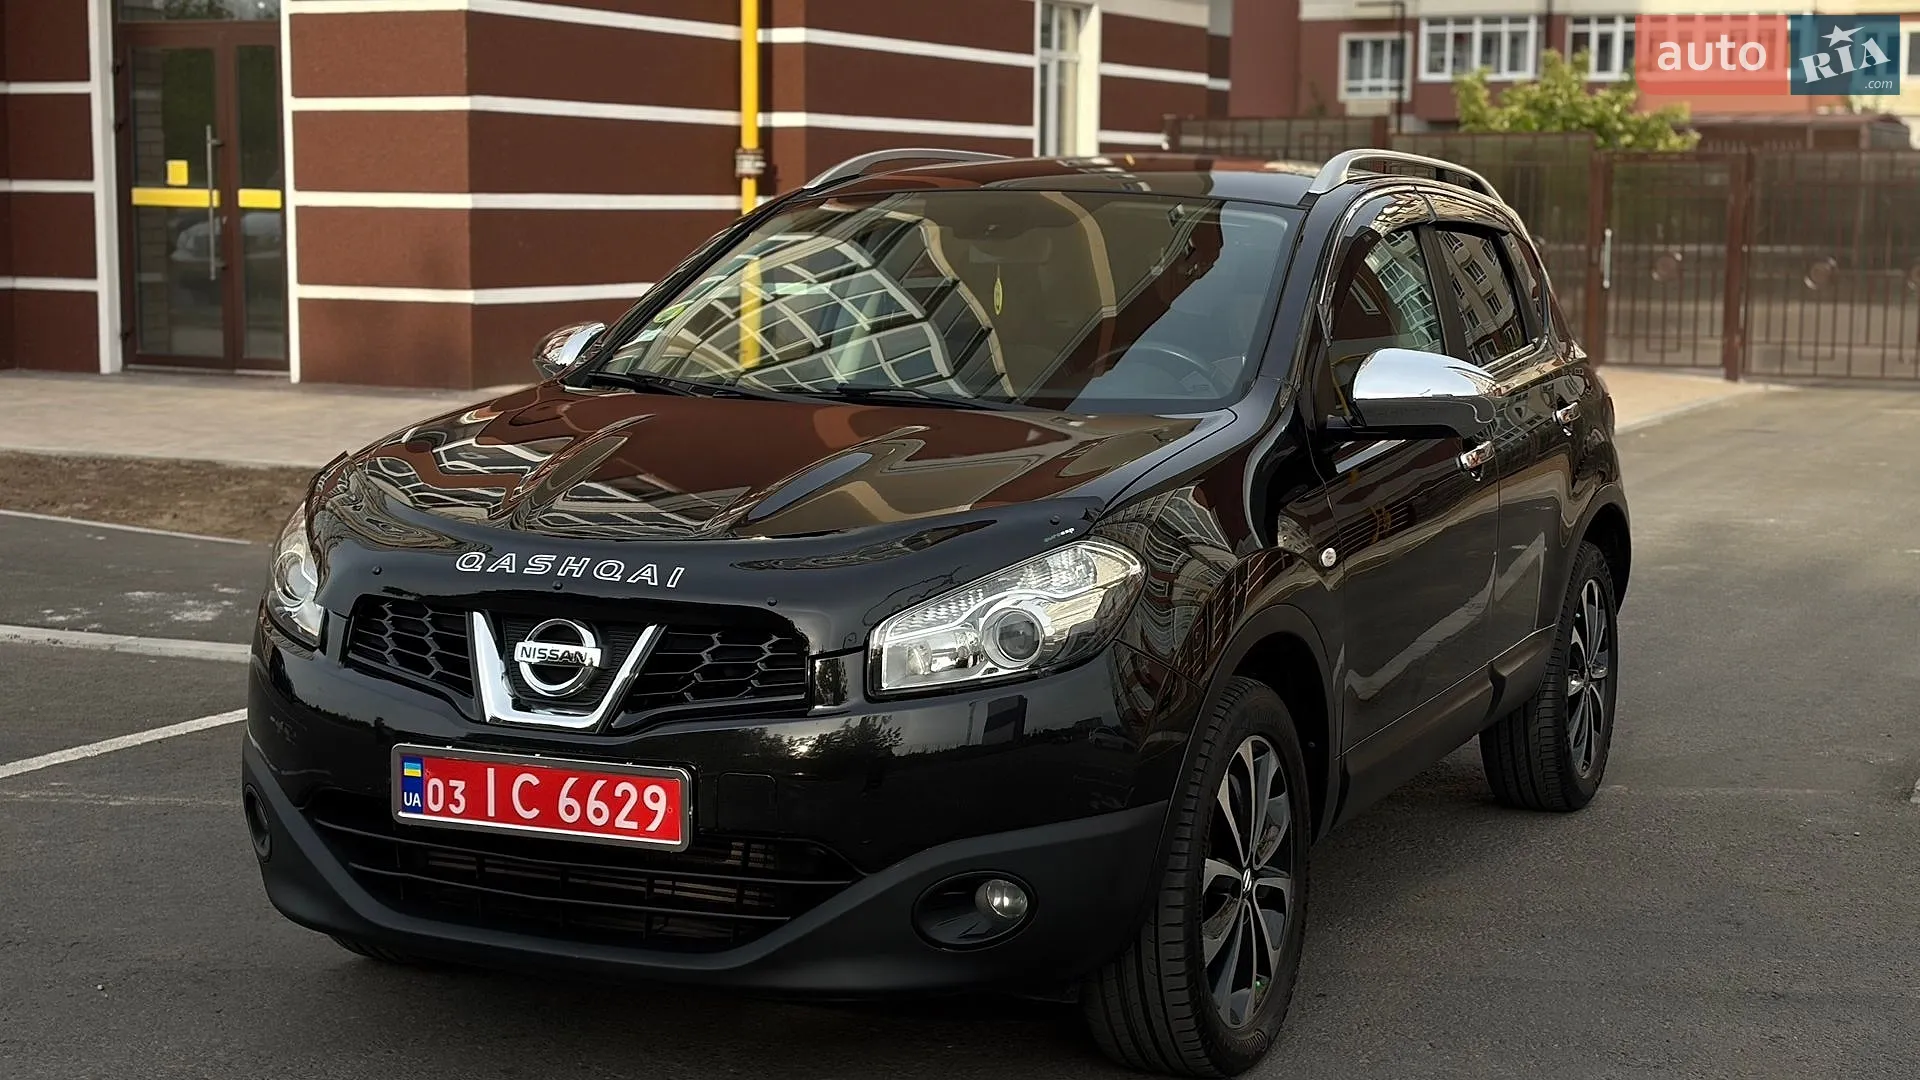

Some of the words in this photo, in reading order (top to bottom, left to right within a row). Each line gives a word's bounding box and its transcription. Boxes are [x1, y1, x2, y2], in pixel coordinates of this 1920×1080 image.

[455, 551, 685, 588] QASHQAI
[520, 646, 588, 663] NISSAN
[403, 791, 422, 808] UA
[426, 777, 467, 815] 03
[557, 776, 668, 832] 6629
